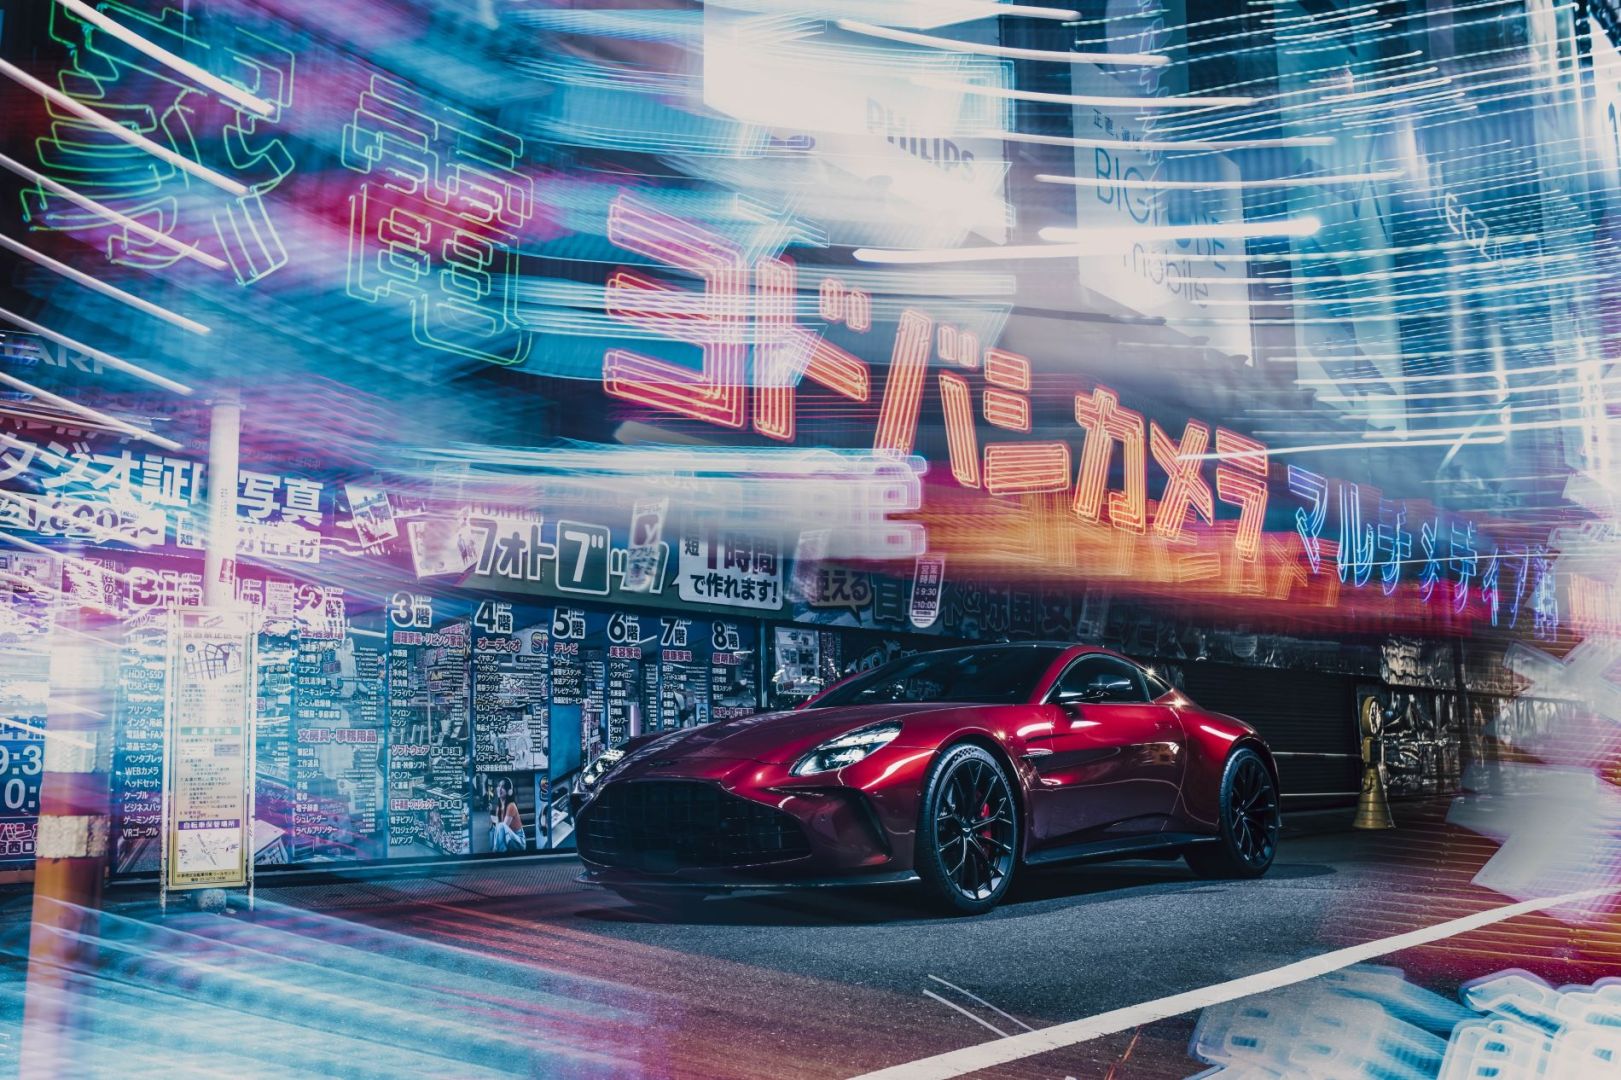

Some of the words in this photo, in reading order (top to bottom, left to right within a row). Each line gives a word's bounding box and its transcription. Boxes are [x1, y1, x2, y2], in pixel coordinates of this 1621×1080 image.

[602, 192, 1270, 562] ヨドバシカメラ
[0, 440, 324, 527] タジオ証写真
[690, 573, 778, 603] で作れます!
[391, 590, 431, 628] 3階
[474, 600, 513, 634] 4階
[552, 606, 586, 640] 5階
[607, 612, 640, 643] 6階
[660, 616, 687, 647] 7階
[477, 638, 522, 653] オーディオ
[712, 621, 739, 650] 8階
[554, 642, 580, 655] テレビ
[299, 666, 321, 674] エアコン
[391, 709, 411, 717] アイロン
[391, 745, 431, 756] ソフトウェア
[124, 766, 159, 776] WEBカメラ
[124, 779, 161, 788] ヘッドセット
[124, 791, 149, 800] ケーブル
[122, 828, 159, 838] VRゴーグル
